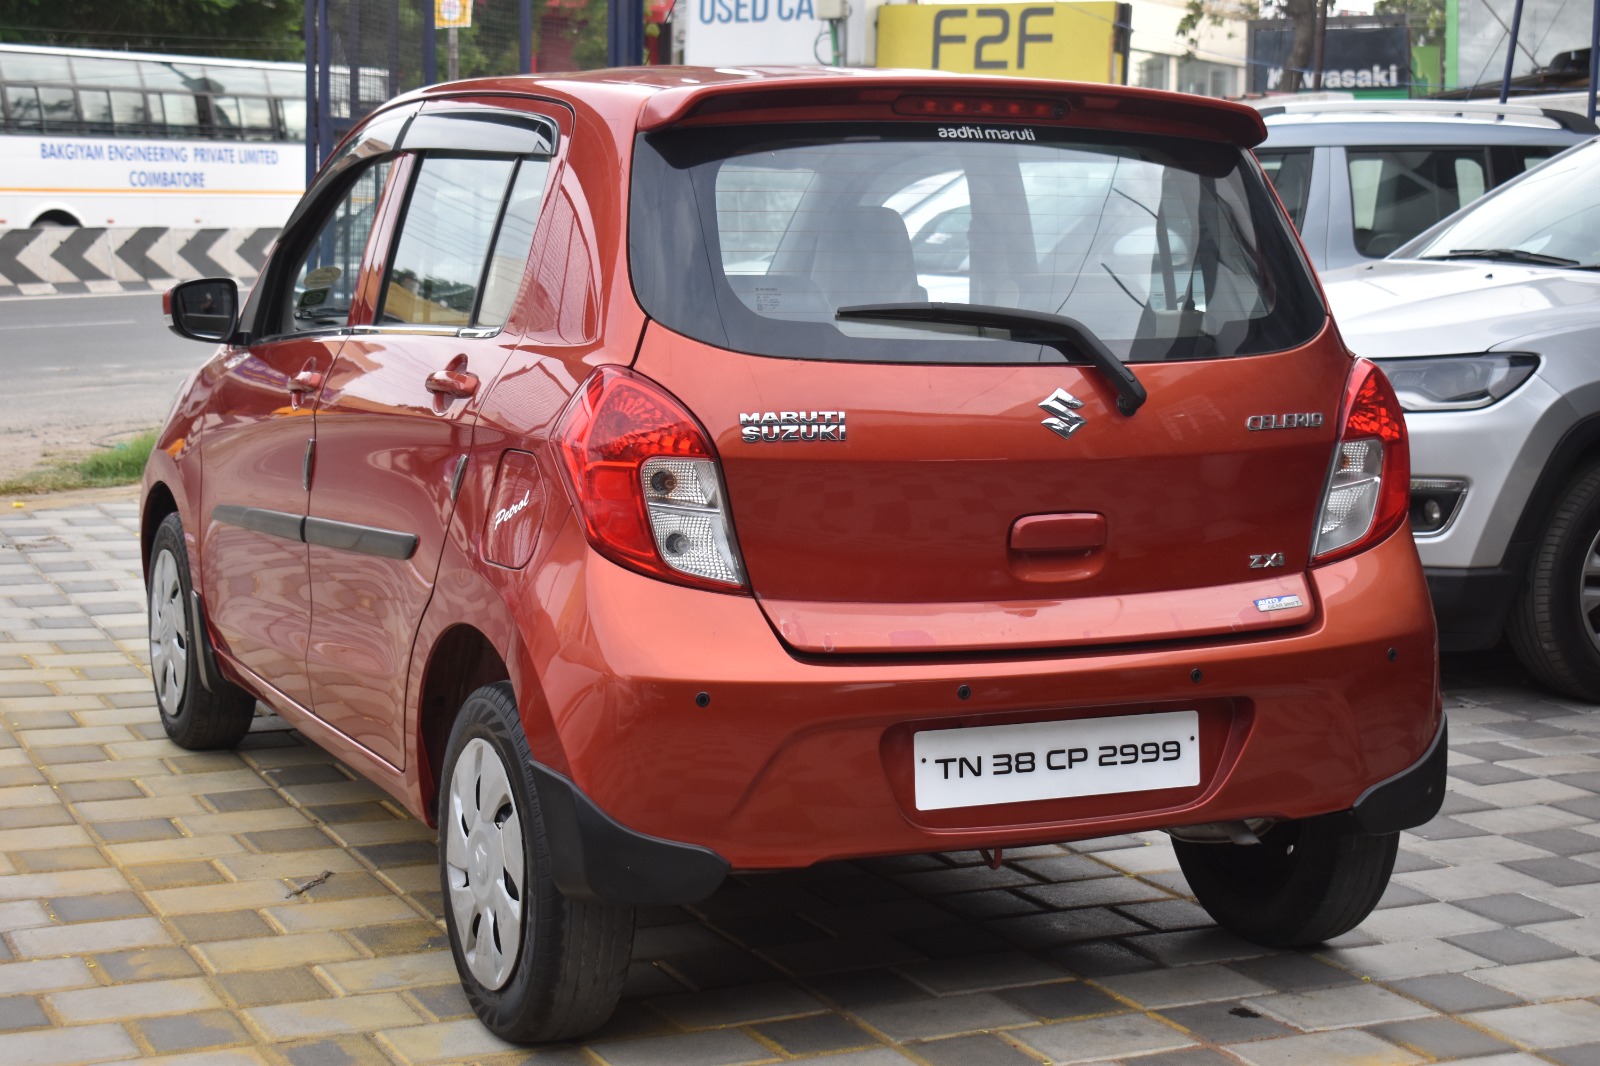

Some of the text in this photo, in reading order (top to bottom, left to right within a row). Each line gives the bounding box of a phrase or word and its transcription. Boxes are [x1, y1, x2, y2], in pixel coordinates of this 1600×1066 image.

[700, 0, 769, 25] USED
[931, 7, 1054, 70] F2F
[1267, 64, 1397, 90] Kwasaki
[938, 126, 1036, 141] aadhi maruti
[40, 143, 279, 165] BAKGIYAM ENGINEERING PRIVATE LIMITED
[129, 170, 206, 188] COIMBATORE
[739, 411, 846, 425] MARUTI
[1246, 413, 1324, 431] CELERIO
[741, 425, 847, 442] SUZUKI
[494, 489, 530, 530] Petrol
[1258, 597, 1279, 606] AUTO
[934, 740, 1182, 780] TN 38 CP 2999
